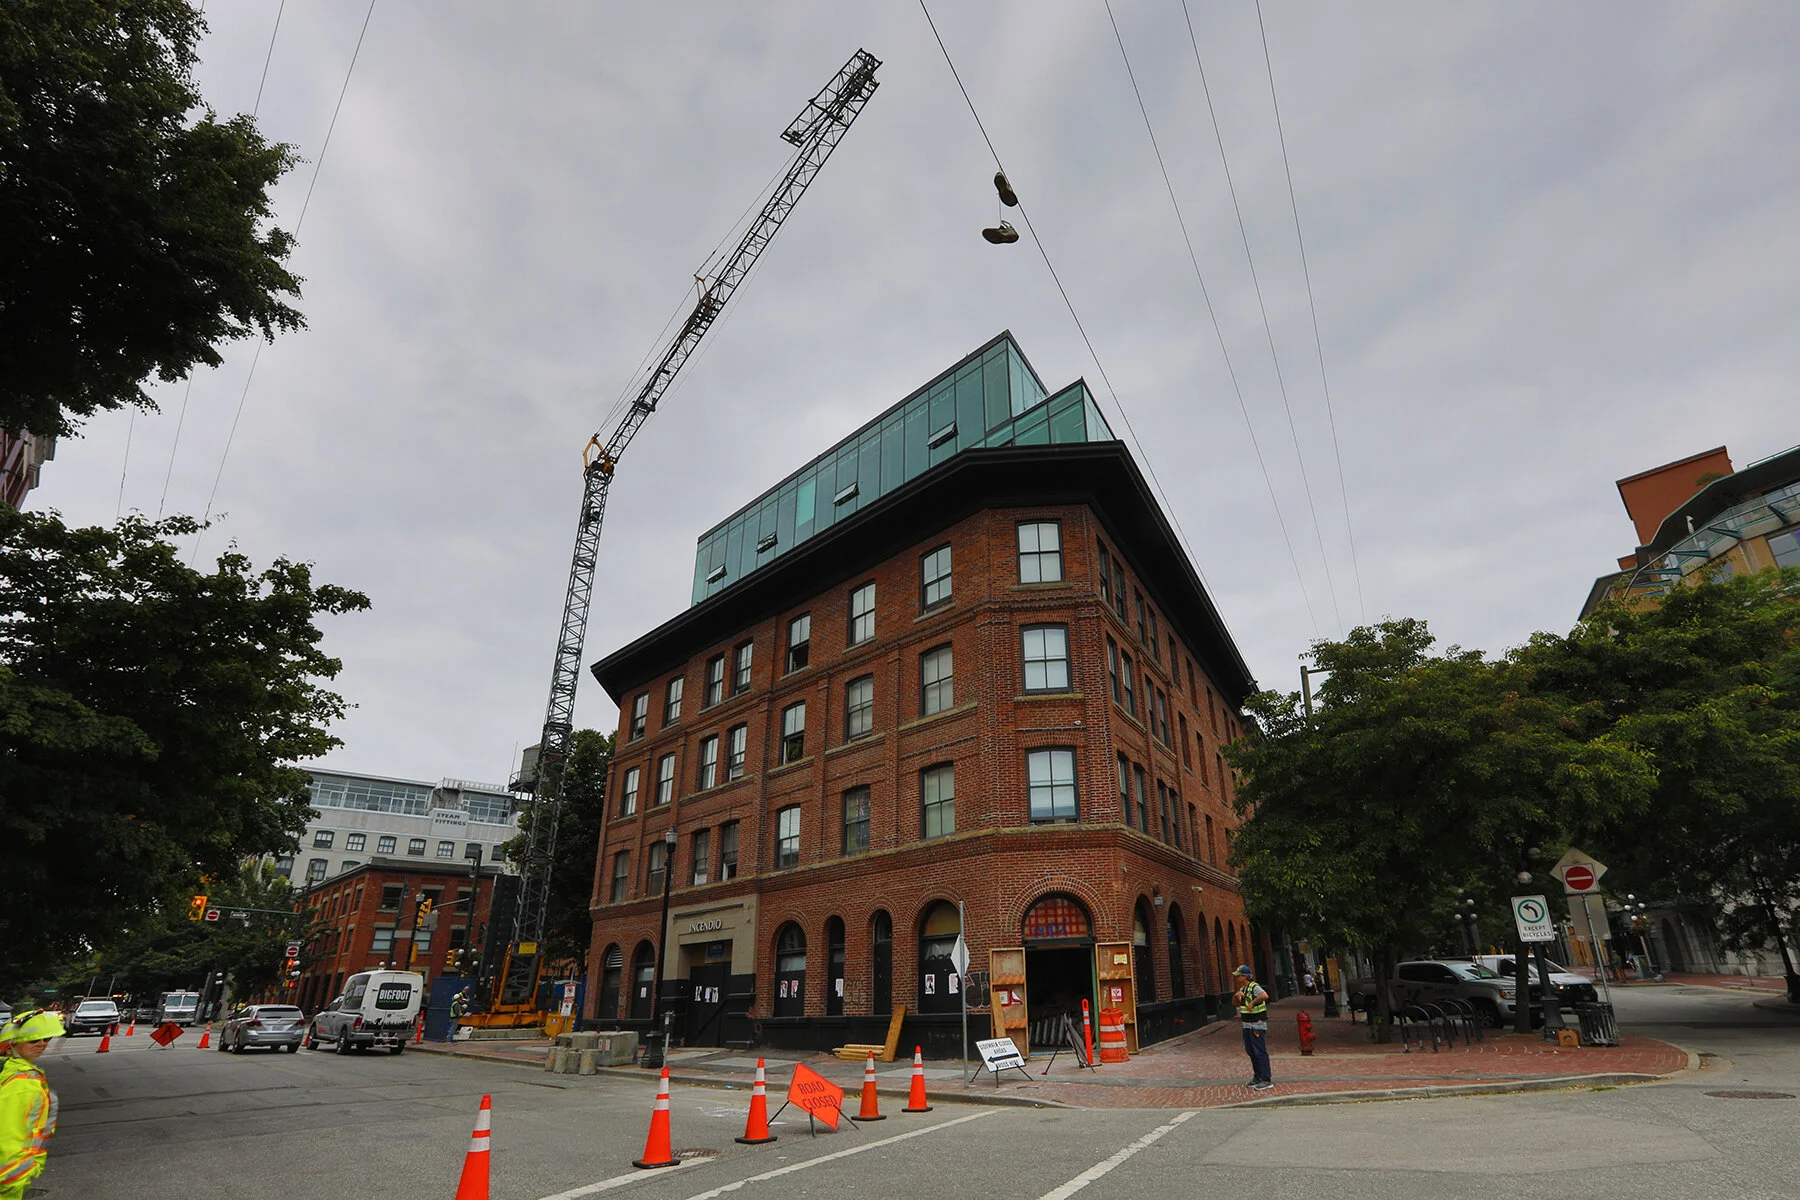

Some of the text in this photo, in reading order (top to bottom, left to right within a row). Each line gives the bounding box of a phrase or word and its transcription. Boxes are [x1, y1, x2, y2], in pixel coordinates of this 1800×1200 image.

[689, 919, 722, 932] INCENDIO
[379, 990, 410, 1000] BIGFOOT
[798, 1081, 825, 1094] ROAD
[803, 1095, 837, 1109] CLOSED
